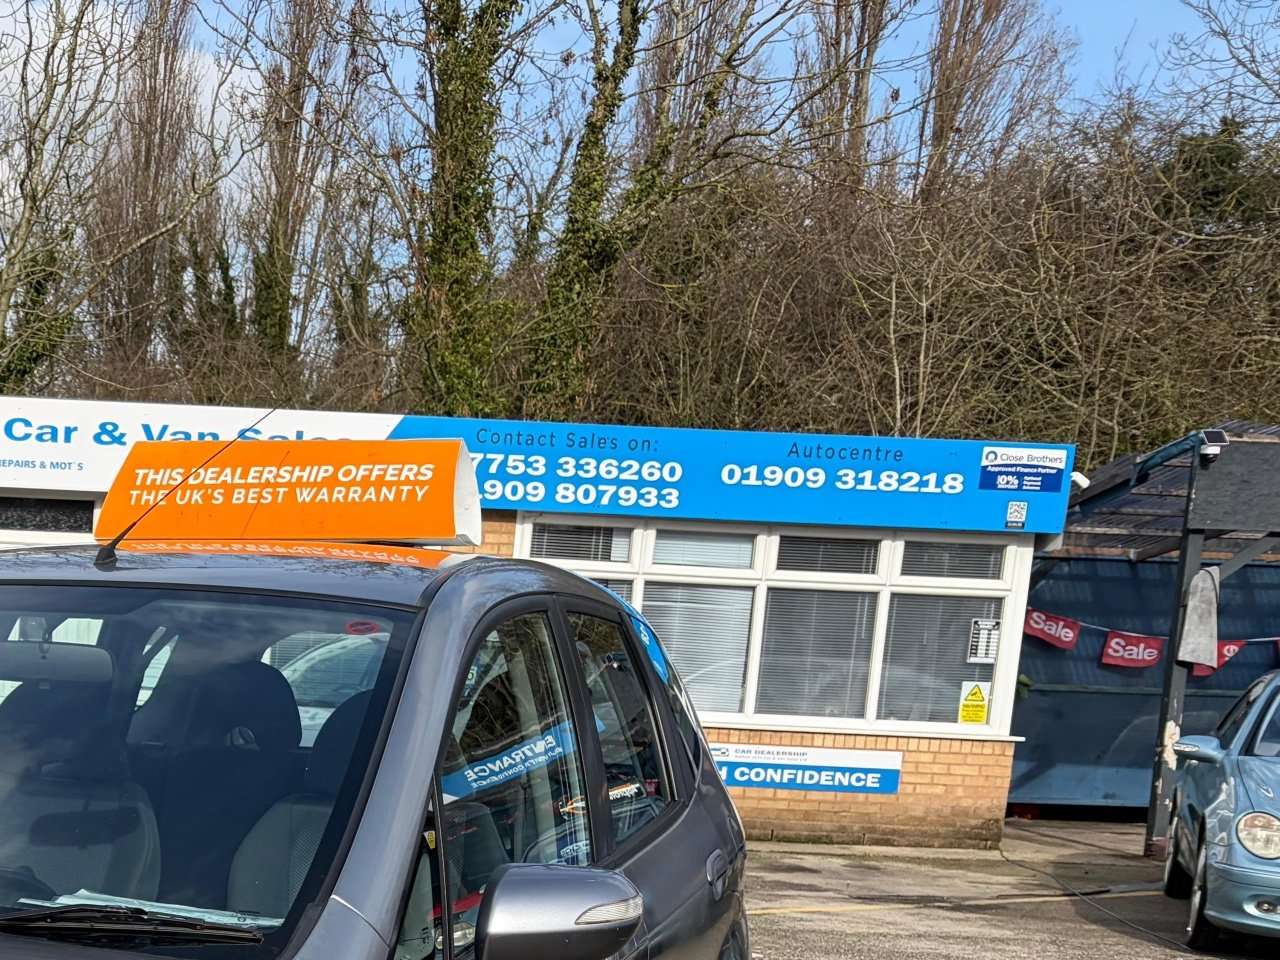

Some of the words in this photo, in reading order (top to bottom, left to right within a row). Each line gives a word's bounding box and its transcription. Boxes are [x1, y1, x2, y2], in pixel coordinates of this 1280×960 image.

[4, 418, 78, 443] Car
[92, 421, 127, 446] &
[476, 428, 556, 447] Contact
[566, 432, 618, 450] Sales
[628, 438, 658, 452] on:
[787, 442, 903, 462] Autocentre
[999, 453, 1025, 462] Close
[1026, 454, 1063, 464] Brothers
[39, 461, 47, 469] &
[135, 468, 184, 486] THIS
[188, 465, 335, 486] DEALERSHIP
[337, 464, 435, 482] OFFERS
[556, 456, 683, 483] 336260
[720, 463, 826, 489] 01909
[835, 468, 964, 494] 318218
[129, 489, 170, 506] THE
[175, 488, 225, 504] UK'S
[231, 487, 288, 504] BEST
[295, 485, 430, 503] WARRANTY
[475, 479, 546, 503] 909
[554, 483, 680, 509] 807933
[1028, 611, 1074, 642] Sale
[1107, 637, 1159, 661] Sale
[734, 767, 881, 788] CONFIDENCE
